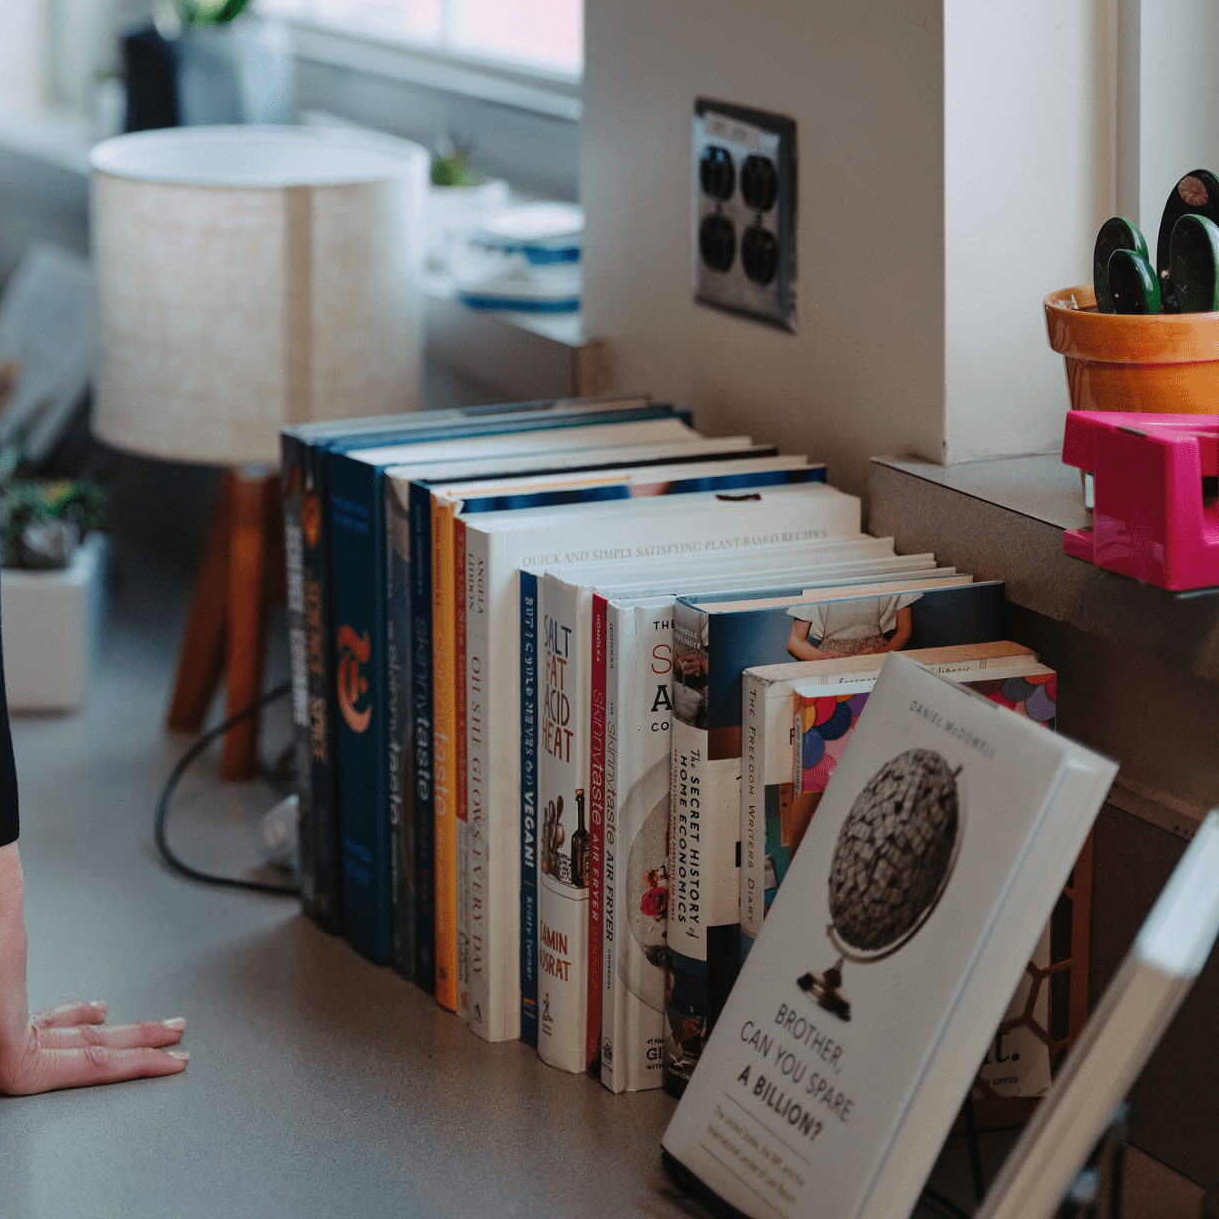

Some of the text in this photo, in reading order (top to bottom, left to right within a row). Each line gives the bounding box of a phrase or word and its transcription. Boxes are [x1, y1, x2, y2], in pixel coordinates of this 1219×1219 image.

[522, 529, 829, 568] QUICK AND SIMPLY SATISFYING PLANT-BASED RECIPES
[477, 556, 485, 615] ANGELA
[524, 596, 534, 628] BUT
[544, 614, 573, 658] SALT
[653, 619, 675, 631] THE
[524, 642, 533, 697] COULD
[546, 649, 567, 691] FAT
[413, 617, 432, 801] skinnytaste
[524, 701, 533, 755] NEVER
[544, 683, 571, 727] ACID
[909, 699, 943, 727] DANIEL
[542, 714, 574, 763] HEAT
[590, 689, 604, 826] skinnytaste
[524, 760, 533, 786] GO
[606, 721, 617, 846] skinnytaste
[471, 656, 482, 980] OH SHE GLOWS EVERY DAY
[523, 790, 535, 869] VEGAN!
[746, 689, 757, 925] THE FREEDOM WRITERS DIARY
[592, 833, 600, 862] AIR
[606, 849, 614, 880] AIR
[678, 754, 688, 925] HOME ECONOMICS
[685, 749, 701, 940] The SECRET HISTORY of
[591, 867, 599, 922] FRYER
[605, 884, 614, 943] FRYER
[524, 896, 534, 982] Kristy Turner
[774, 1003, 844, 1074] BROTHER,
[740, 1020, 856, 1123] CAN YOU SPARE
[992, 1076, 1019, 1086] KIPFER
[737, 1064, 824, 1141] A BILLION?
